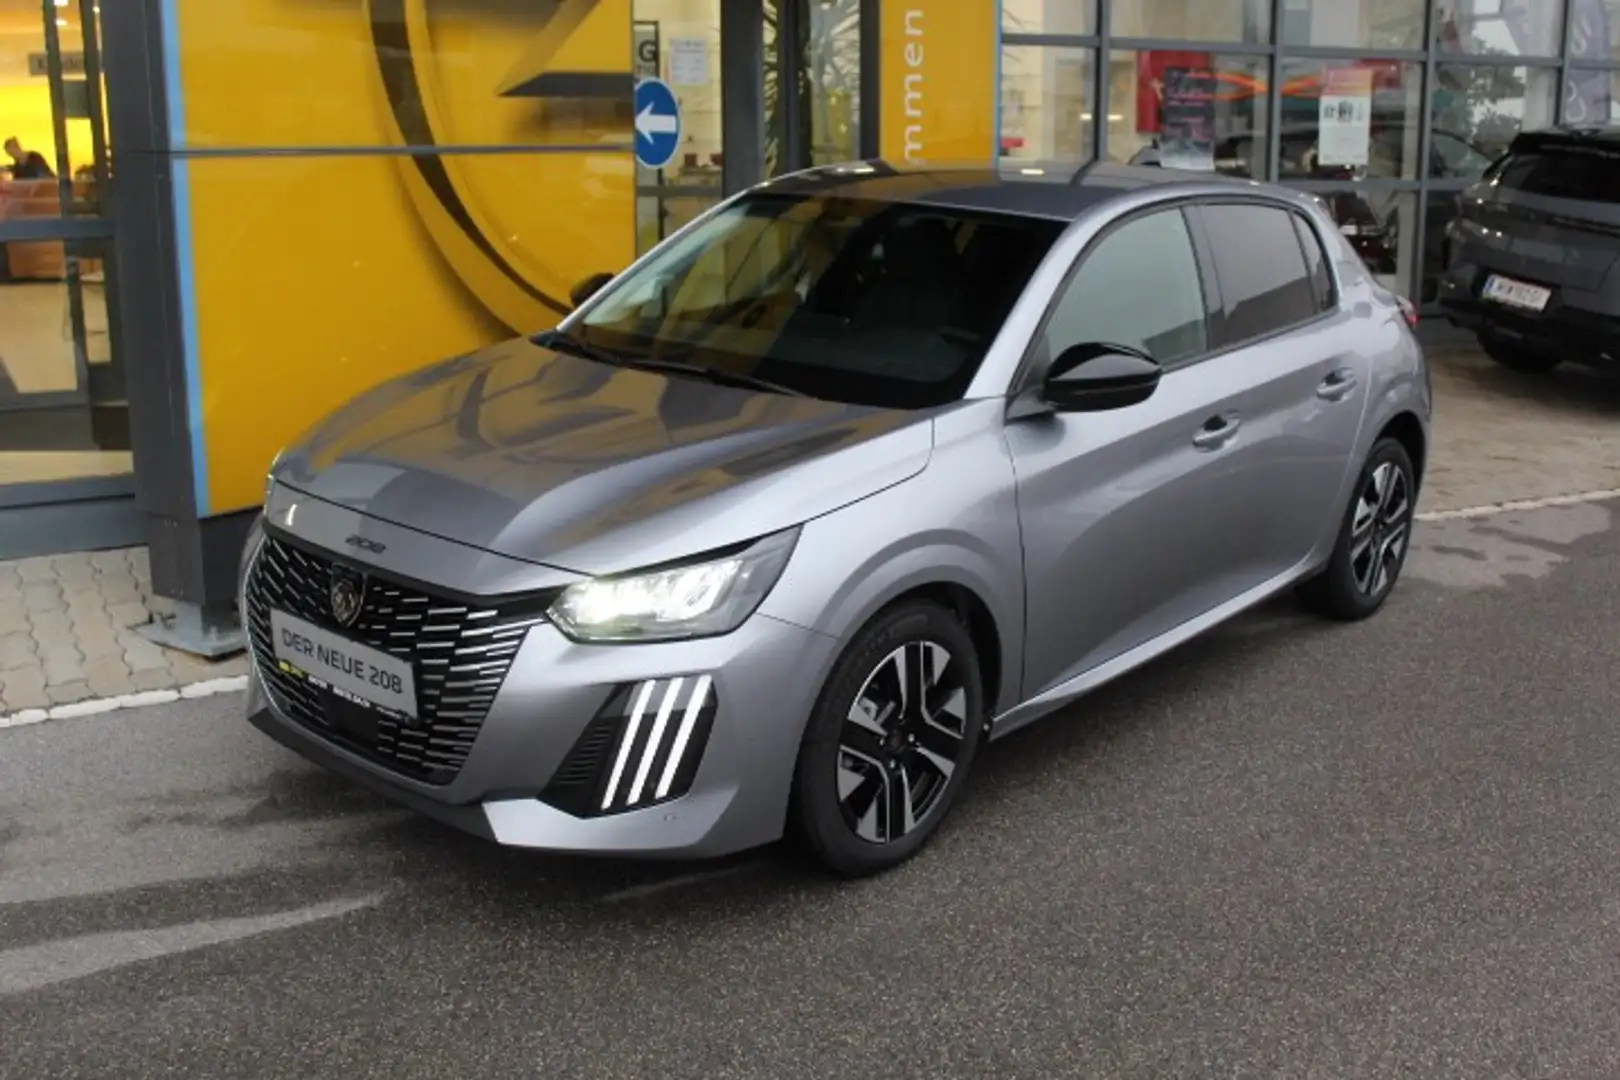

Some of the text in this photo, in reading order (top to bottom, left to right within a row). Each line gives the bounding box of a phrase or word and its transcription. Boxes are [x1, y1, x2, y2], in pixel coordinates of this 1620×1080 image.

[281, 627, 315, 658] DER
[317, 643, 365, 681] NEUE
[368, 664, 404, 695] 208
